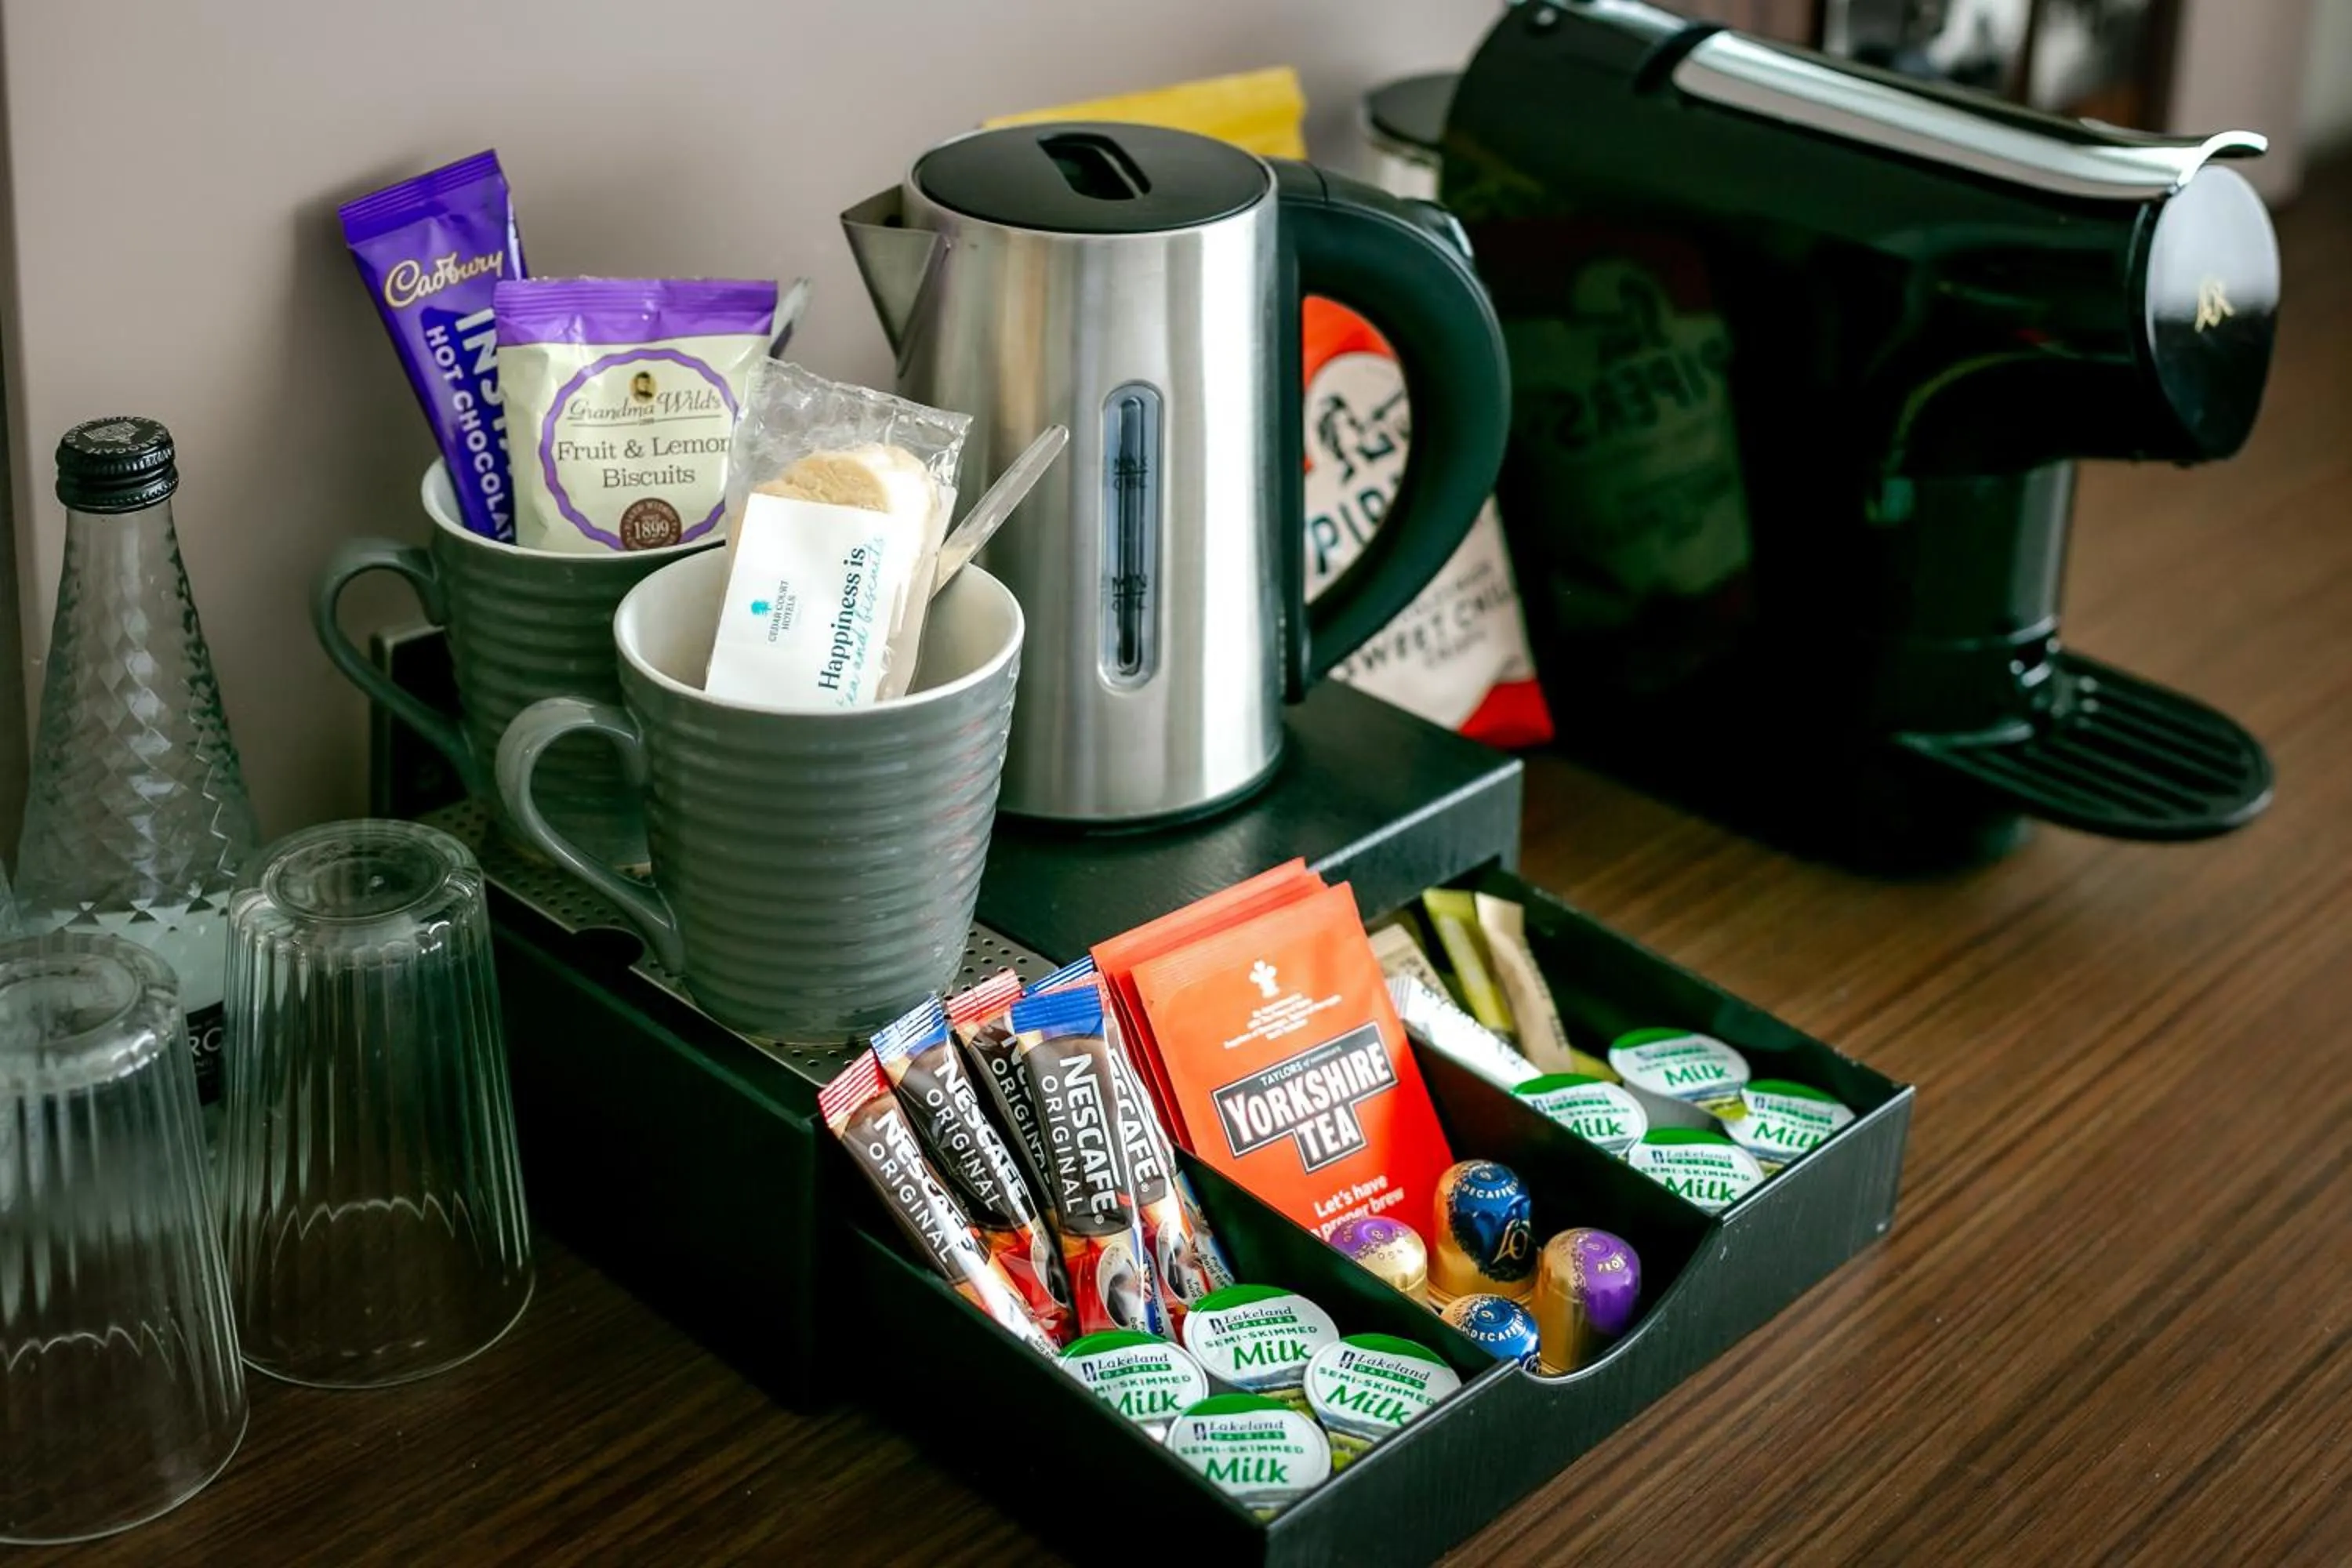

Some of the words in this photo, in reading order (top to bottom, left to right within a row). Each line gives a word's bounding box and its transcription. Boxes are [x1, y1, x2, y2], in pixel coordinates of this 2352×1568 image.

[384, 250, 503, 308] Cadbury
[569, 396, 655, 420] Grandma
[656, 389, 721, 414] Wild's
[426, 325, 463, 381] HOT
[452, 391, 514, 539] CHOCOLAT
[557, 441, 616, 461] Fruit
[624, 438, 644, 459] &
[602, 465, 695, 488] Biscuits
[634, 519, 670, 540] 1899
[818, 572, 861, 691] Happiness
[844, 547, 866, 567] is
[1260, 1061, 1303, 1087] TAYLORS
[1664, 1064, 1732, 1087] Milk
[1223, 1042, 1391, 1145] YORKSHIRE
[1042, 1075, 1083, 1213] ORIGINAL
[1297, 1105, 1361, 1163] TEA
[926, 1088, 1001, 1211] ORIGINAL
[869, 1142, 955, 1263] ORIGINAL
[1313, 1189, 1353, 1218] Let's
[1351, 1174, 1388, 1200] have
[1368, 1187, 1405, 1214] brew
[1665, 1177, 1737, 1203] Milk
[1224, 1305, 1293, 1323] Lakeland
[1204, 1326, 1318, 1349] SEMI-SKIMMED
[1098, 1353, 1168, 1370] Lakeland
[1232, 1338, 1313, 1370] Milk
[1357, 1354, 1431, 1381] Lakeland
[1094, 1374, 1192, 1394] MI-SKIMMED
[1318, 1367, 1436, 1406] SEMI-SKIMMED
[1101, 1390, 1184, 1417] Milk
[1325, 1384, 1411, 1426] Milk
[1210, 1419, 1284, 1432] Lakeland
[1181, 1445, 1304, 1454] SEMI-SKIMMED
[1205, 1457, 1289, 1484] Milk
